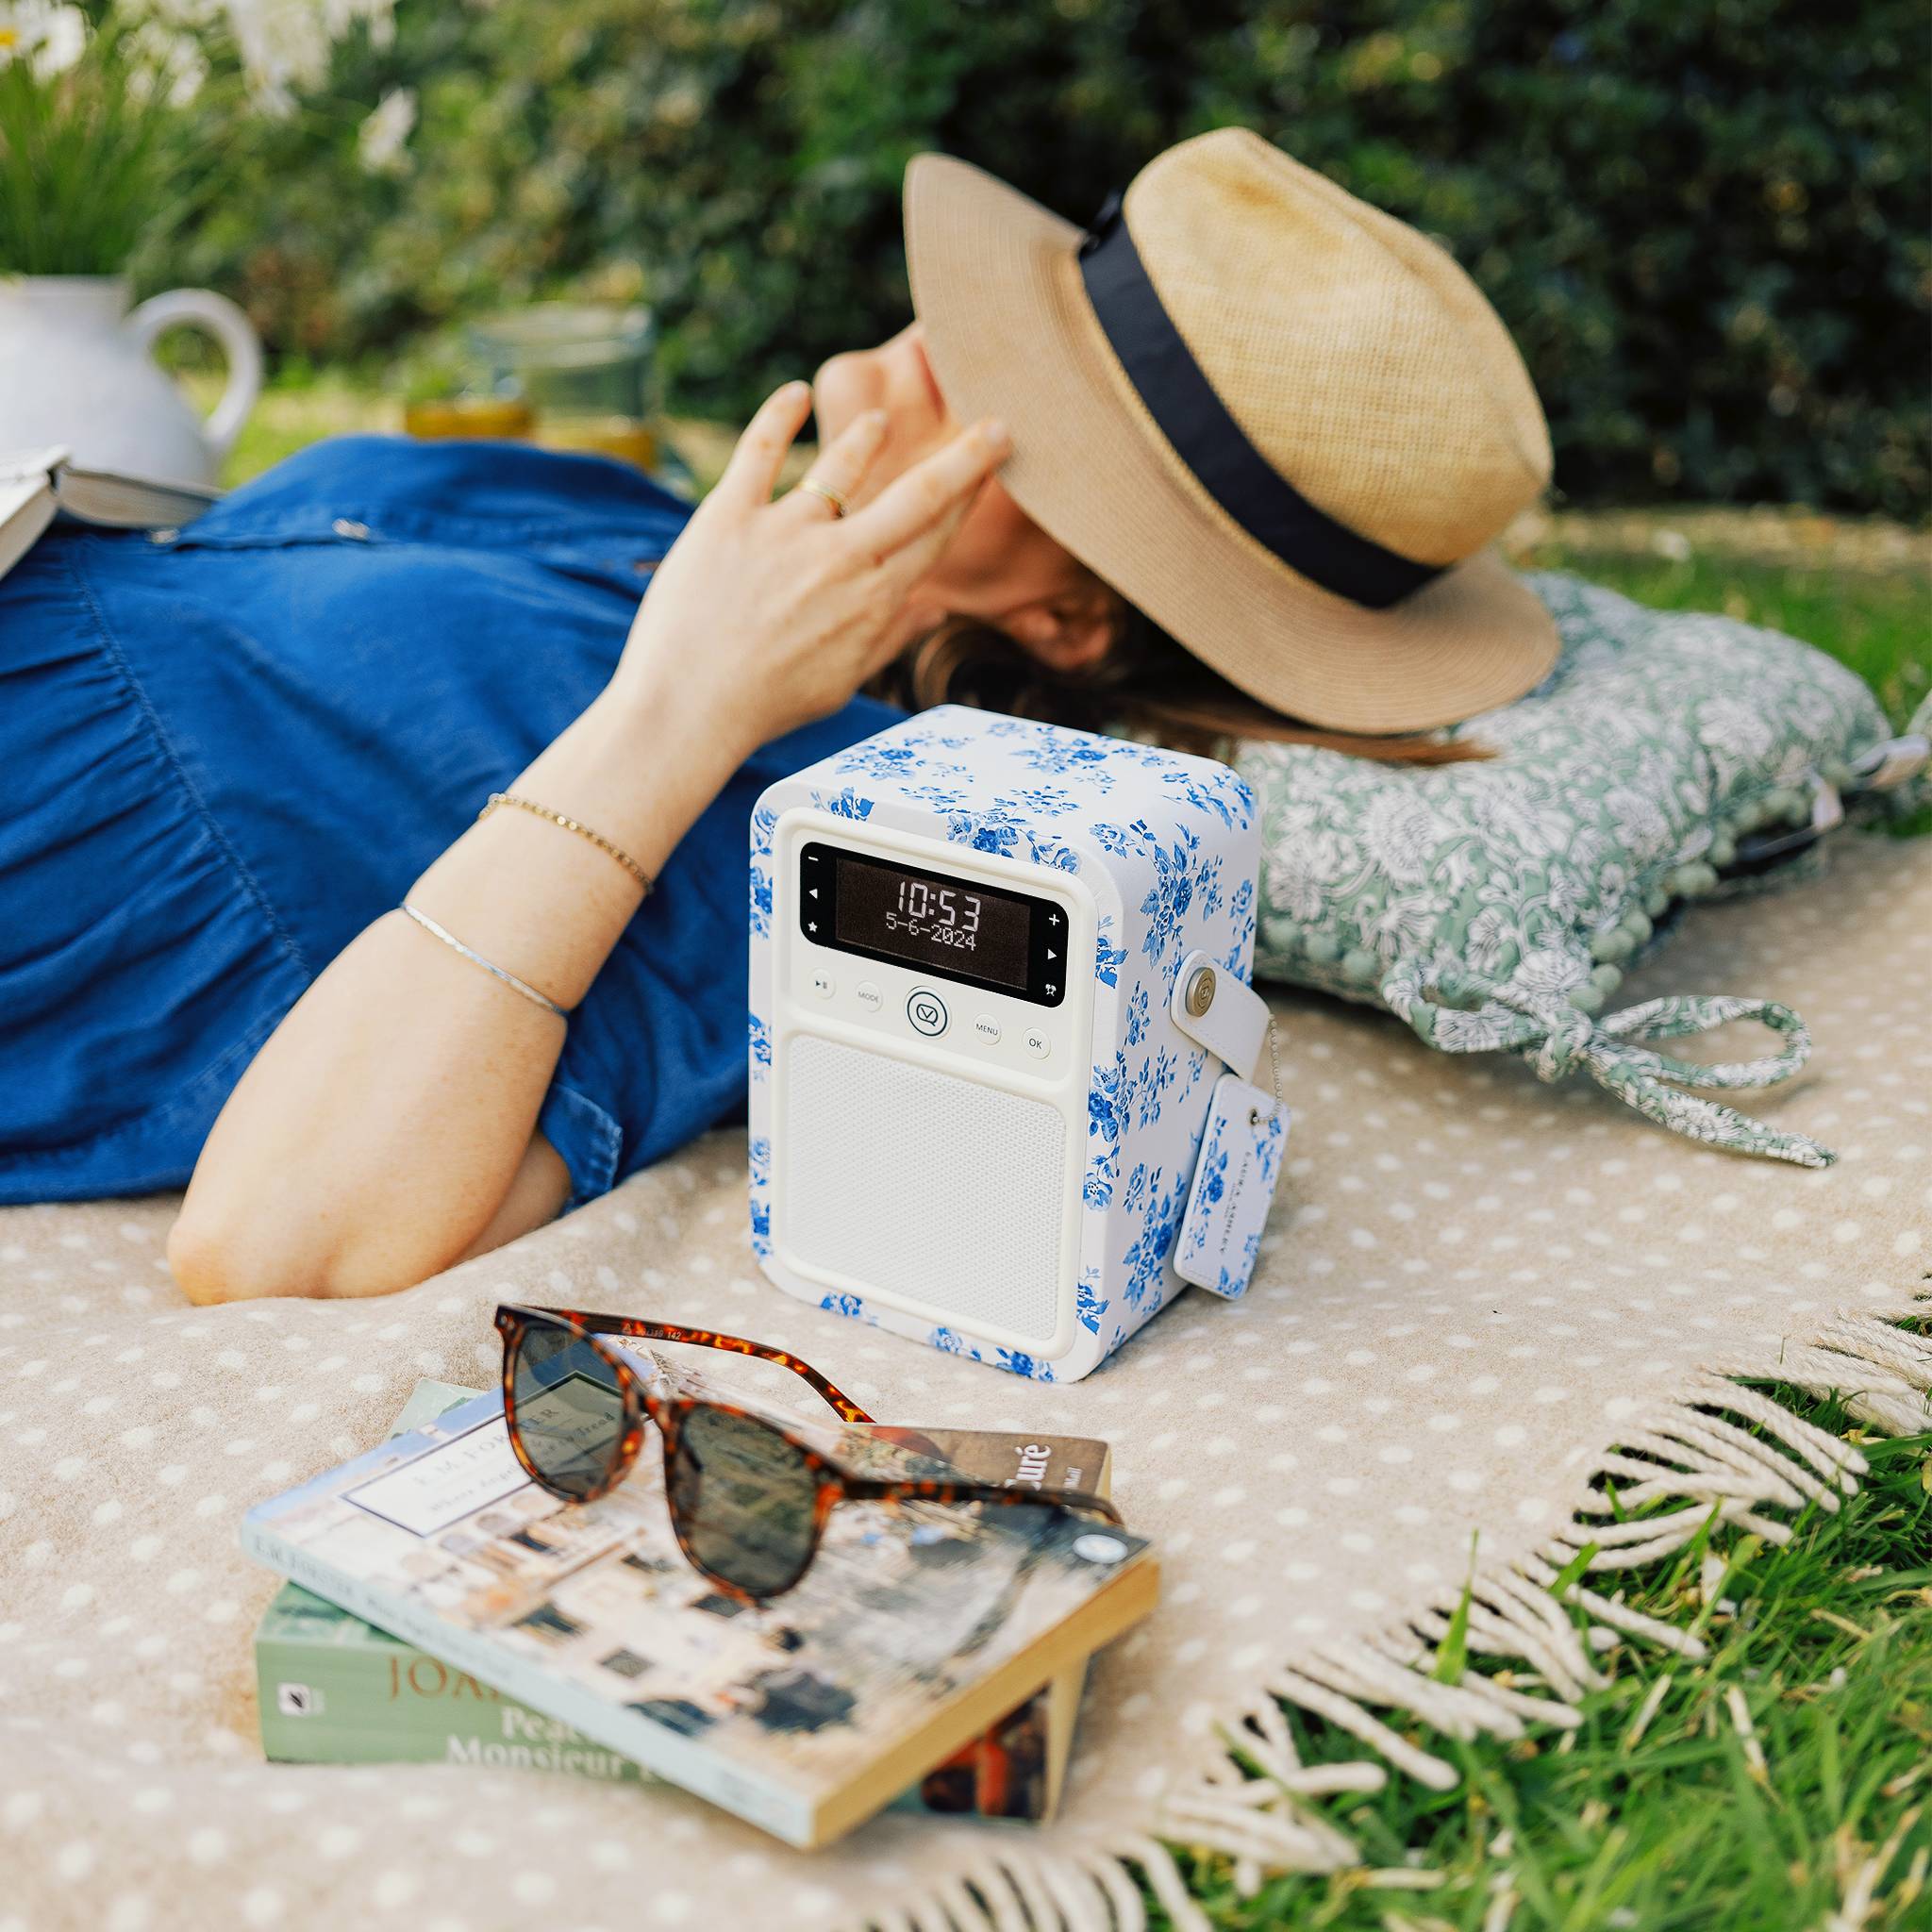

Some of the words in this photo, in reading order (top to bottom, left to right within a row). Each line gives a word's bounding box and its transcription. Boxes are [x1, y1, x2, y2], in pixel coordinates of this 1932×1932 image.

[897, 881, 981, 932] 10:53
[885, 911, 977, 952] 5-6-2024
[858, 990, 880, 1004] MODE
[974, 1023, 999, 1037] MENU
[1028, 1037, 1043, 1049] OK
[667, 1330, 682, 1341] 142
[445, 1733, 624, 1780] Monsieur
